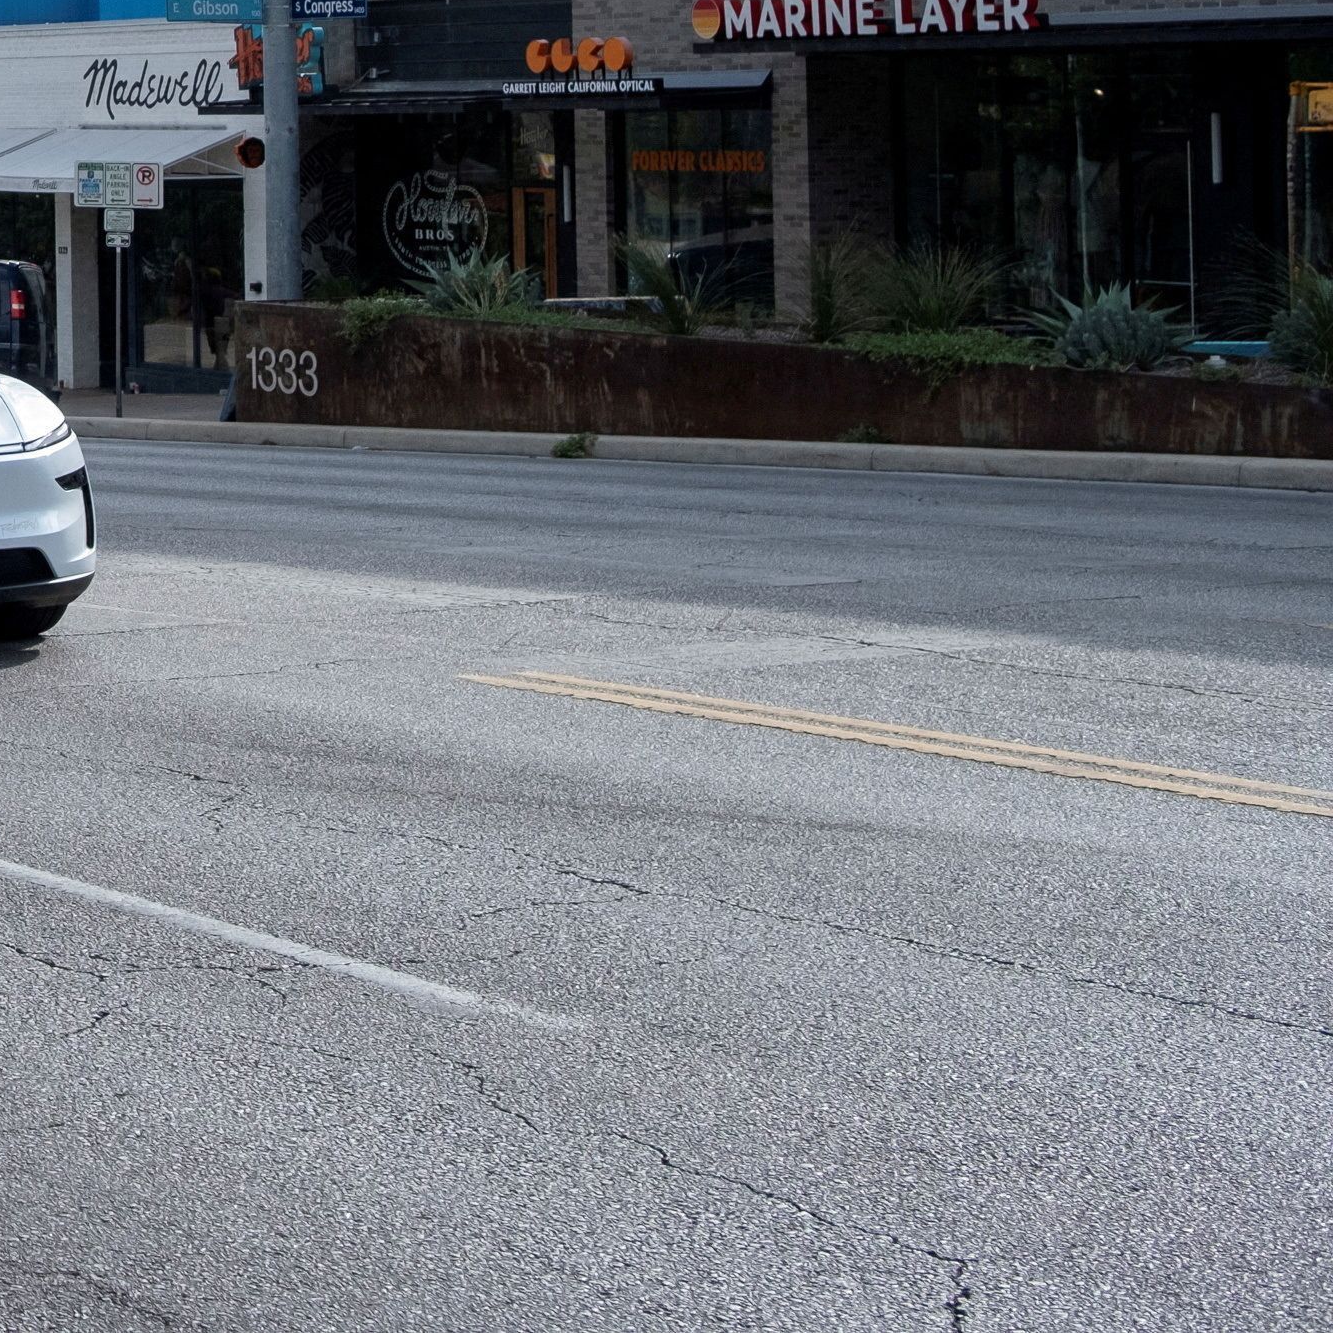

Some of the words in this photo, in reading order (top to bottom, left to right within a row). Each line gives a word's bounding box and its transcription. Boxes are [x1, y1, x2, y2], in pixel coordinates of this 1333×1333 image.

[173, 2, 180, 14] E
[192, 0, 239, 16] Gibson
[295, 1, 301, 13] S
[83, 57, 224, 121] Madewell
[502, 82, 537, 94] GARRETT
[538, 81, 566, 93] LEIGHT
[567, 80, 617, 93] CALIFORNIA
[619, 79, 655, 92] OPTICAL
[632, 150, 695, 171] FOREVER
[698, 149, 766, 172] CLASSICS
[415, 228, 455, 241] BROS
[245, 346, 319, 397] 1333
